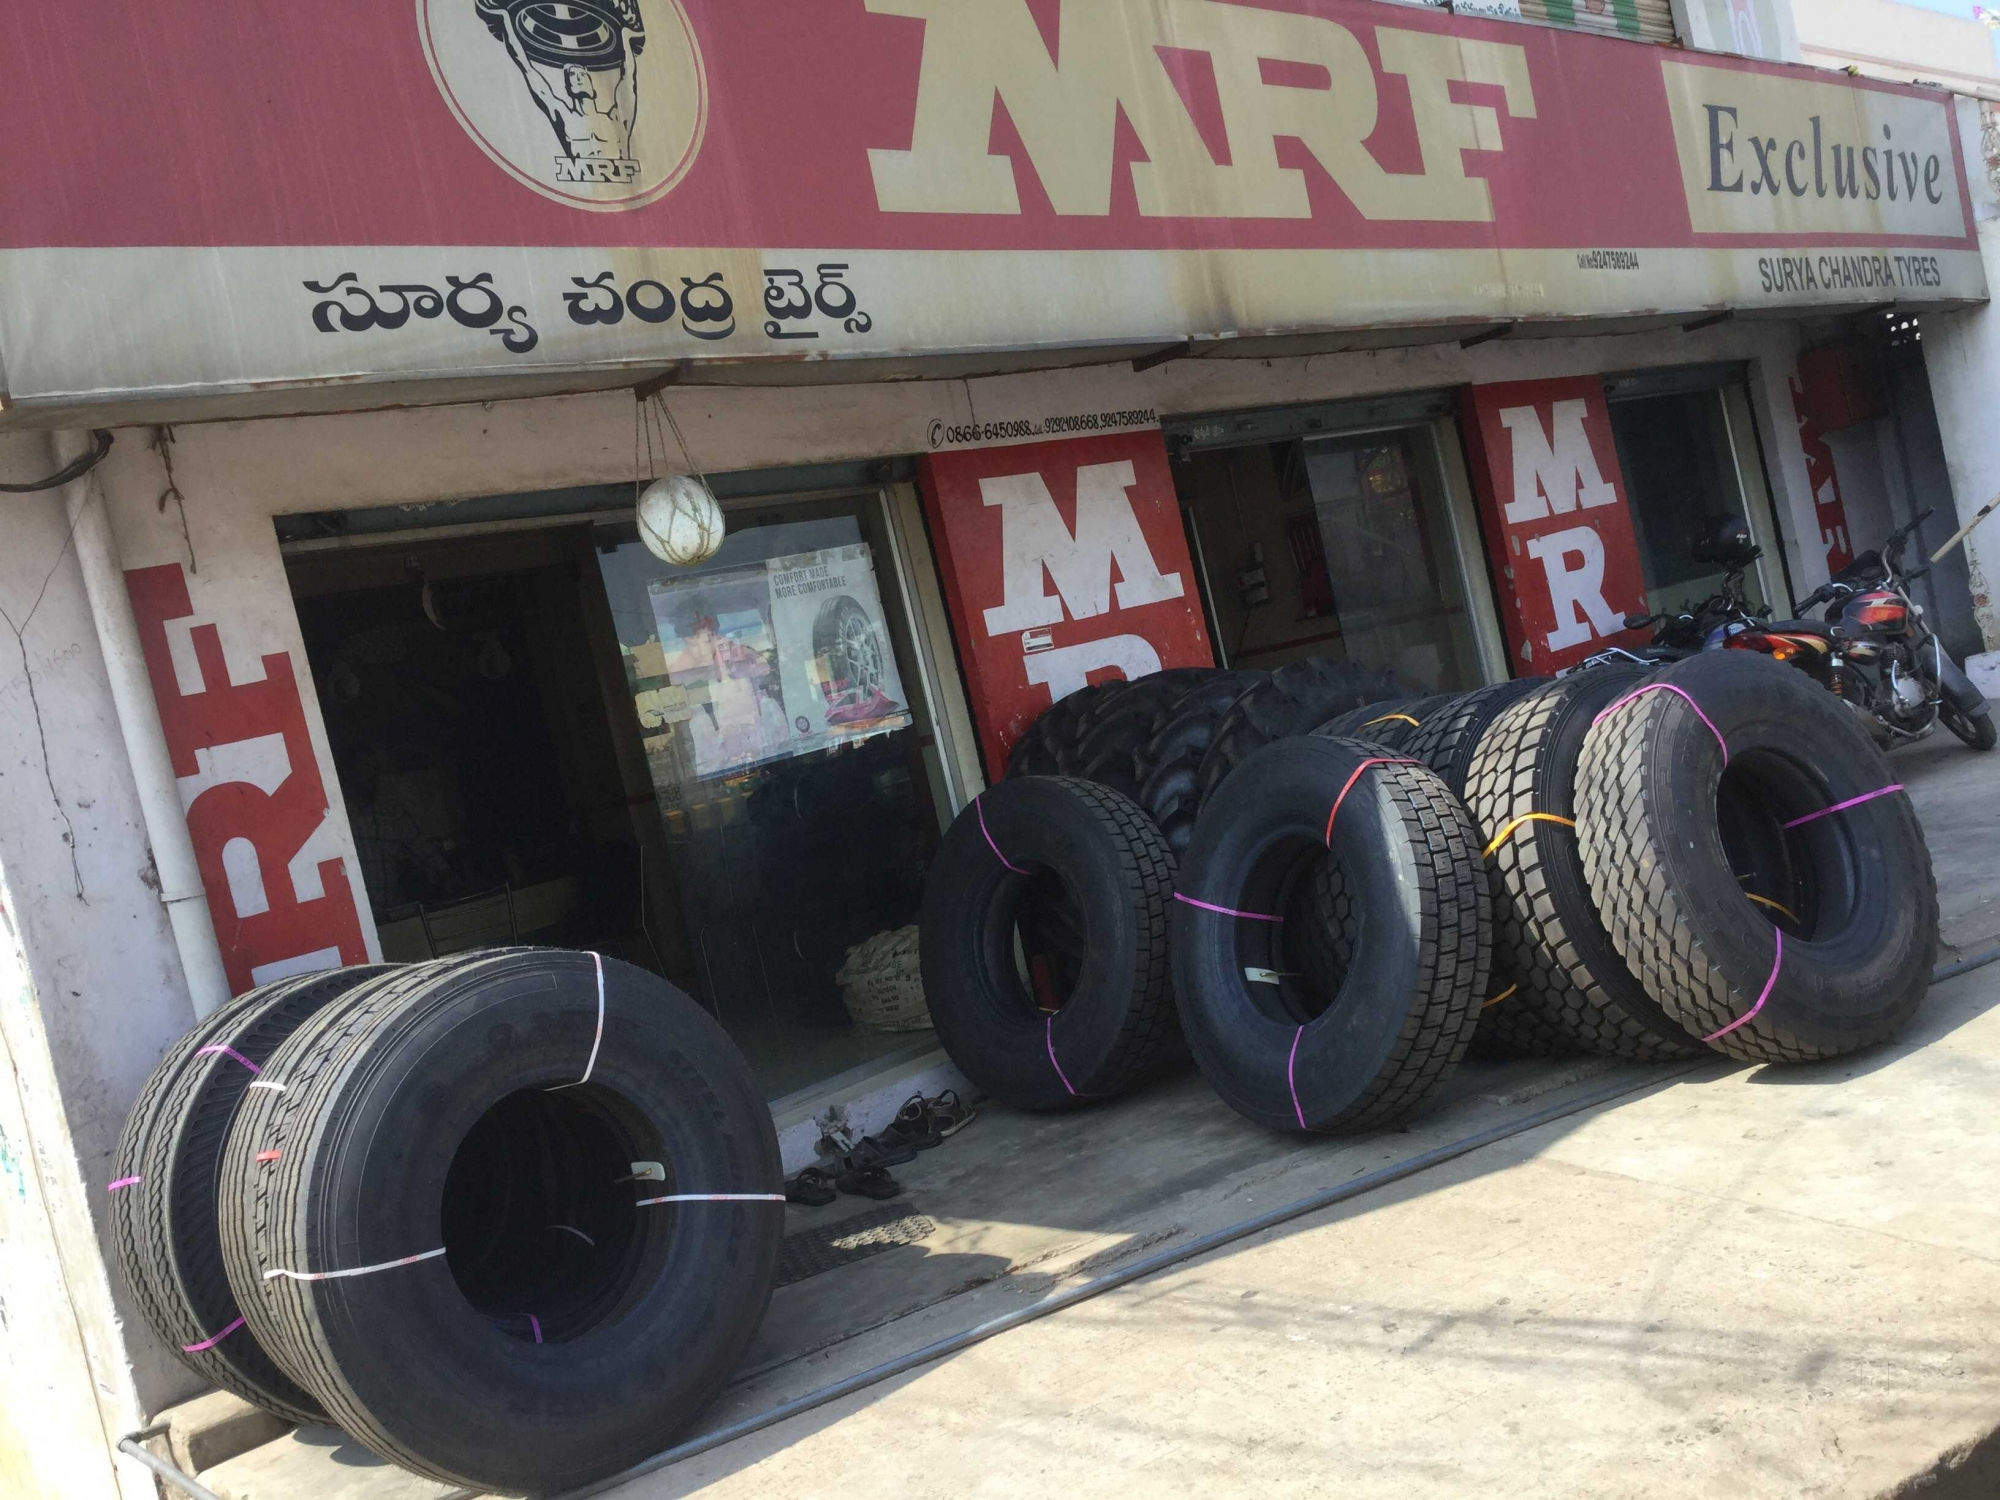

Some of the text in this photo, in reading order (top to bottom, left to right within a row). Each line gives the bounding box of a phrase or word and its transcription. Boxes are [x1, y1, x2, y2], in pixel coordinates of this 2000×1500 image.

[865, 0, 1537, 222] MRF
[554, 156, 640, 183] MRF
[1703, 104, 1942, 204] Exclusive
[1758, 256, 1941, 292] SURYA CHANDRA TYRES
[302, 263, 872, 353] సూర్య చంద్ర టైర్స్
[773, 565, 828, 586] COMFORT MADE
[774, 576, 847, 600] MORE COMFORTABLE
